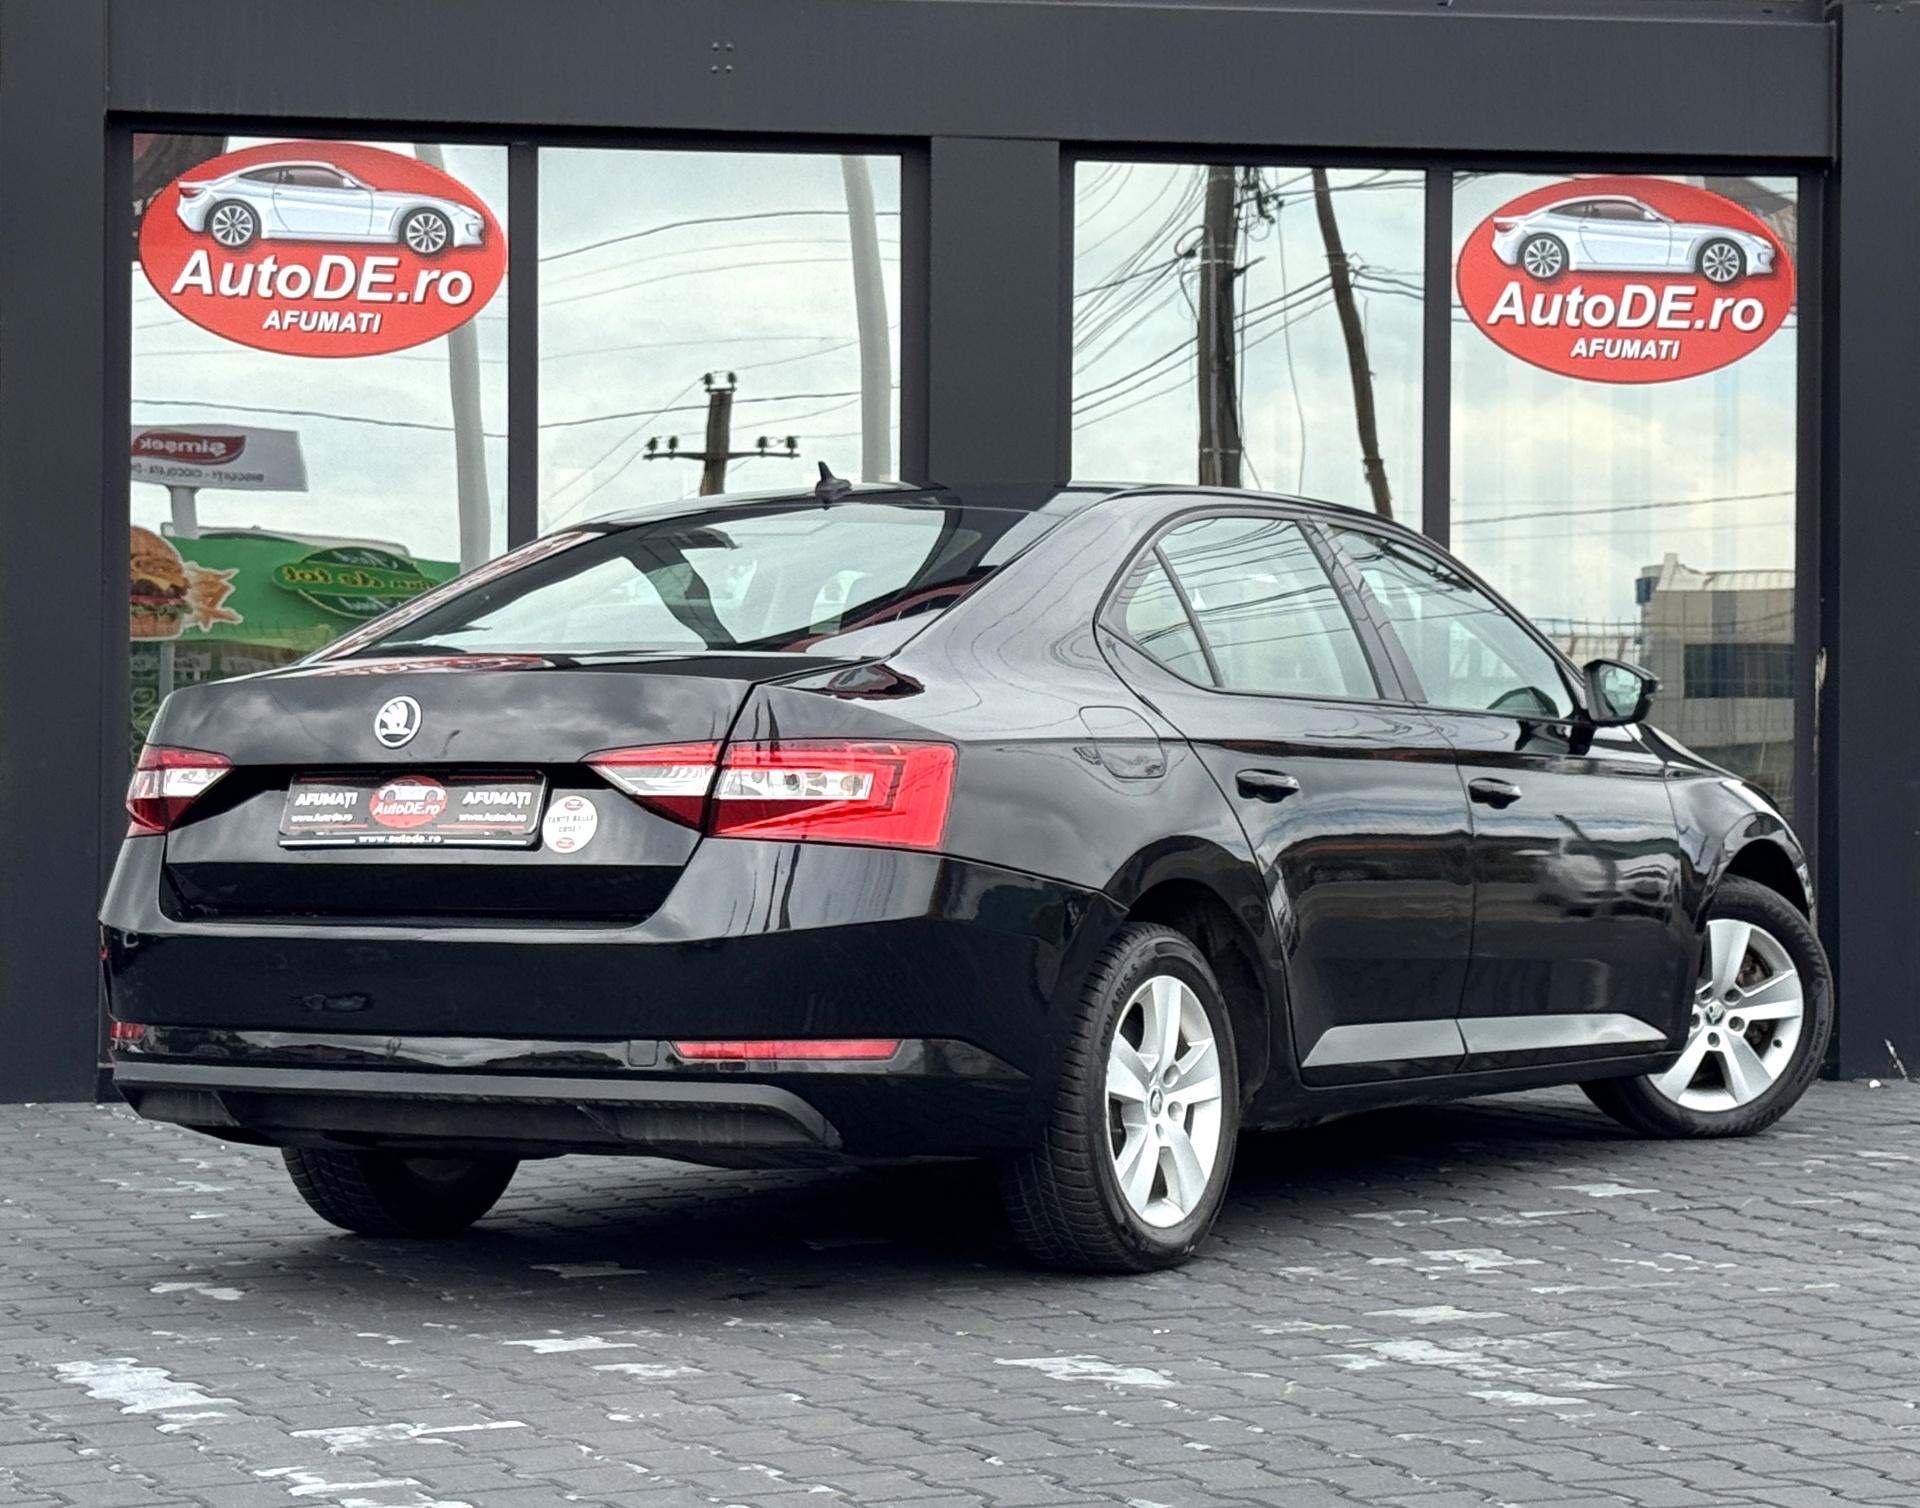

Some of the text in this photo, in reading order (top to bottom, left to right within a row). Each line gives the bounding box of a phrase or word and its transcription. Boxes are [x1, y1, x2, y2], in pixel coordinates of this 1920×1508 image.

[171, 249, 474, 306] AutoDE.ro
[262, 309, 383, 334] AFUMATI
[1487, 281, 1765, 331] AutoDE.ro
[1570, 338, 1681, 361] AFUMATI
[372, 801, 441, 817] AutoDE.ro
[1099, 973, 1132, 1048] POLARIS
